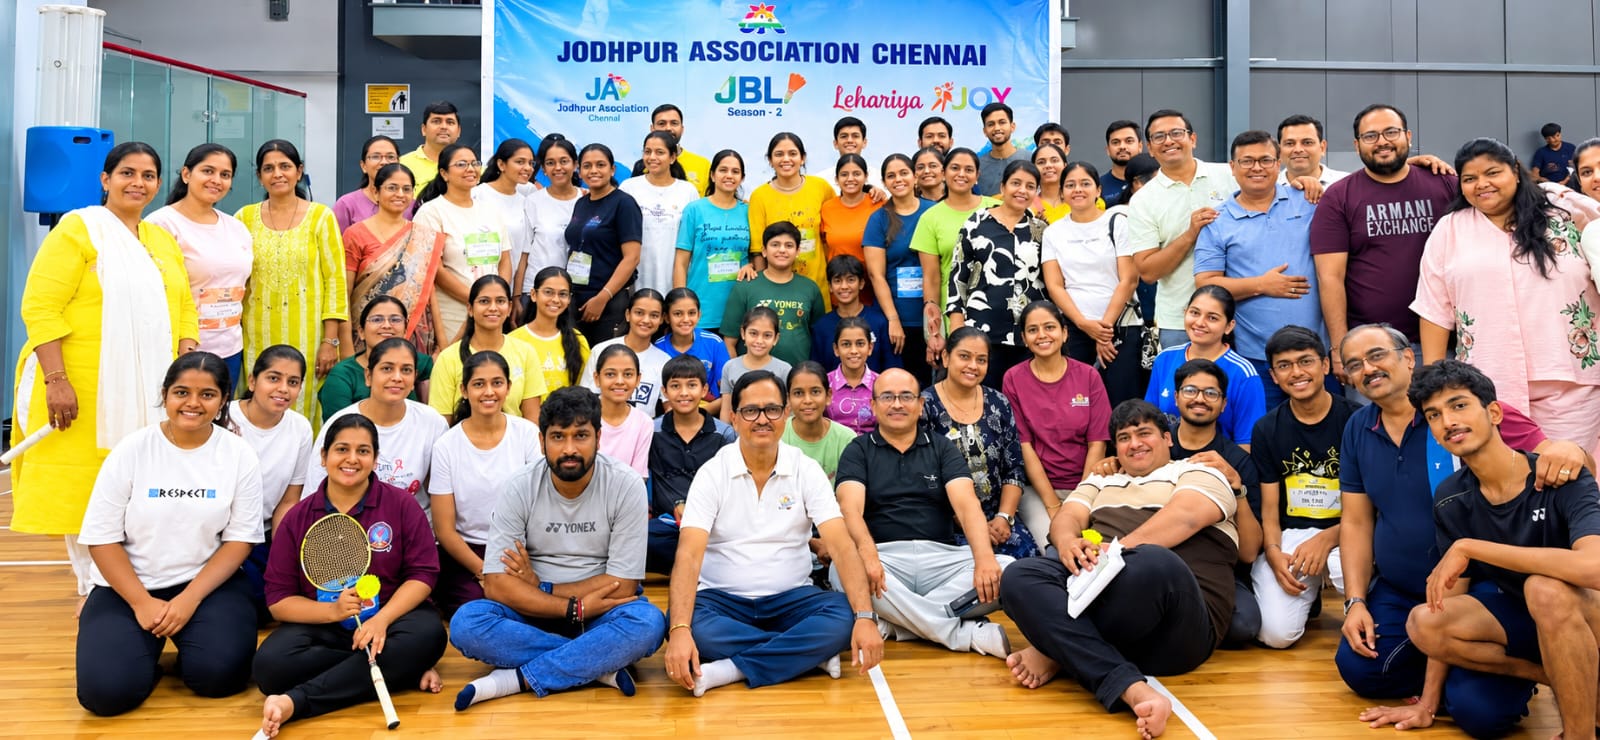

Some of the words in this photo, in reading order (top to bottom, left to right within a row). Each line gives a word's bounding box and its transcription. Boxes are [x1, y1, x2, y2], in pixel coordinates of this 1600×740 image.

[557, 41, 678, 63] JODHPUR
[688, 41, 859, 64] ASSOCIATION
[872, 43, 987, 66] CHENNAI
[714, 76, 783, 104] JBL
[952, 86, 1012, 111] JOY
[557, 103, 596, 114] Jodhpur
[727, 107, 766, 117] Season
[775, 107, 783, 117] 2
[833, 85, 924, 119] Lehariya
[1366, 199, 1434, 222] ARMANI
[1366, 217, 1434, 237] EXCHANGE
[159, 488, 207, 498] RESPECT
[564, 521, 596, 533] YONEX
